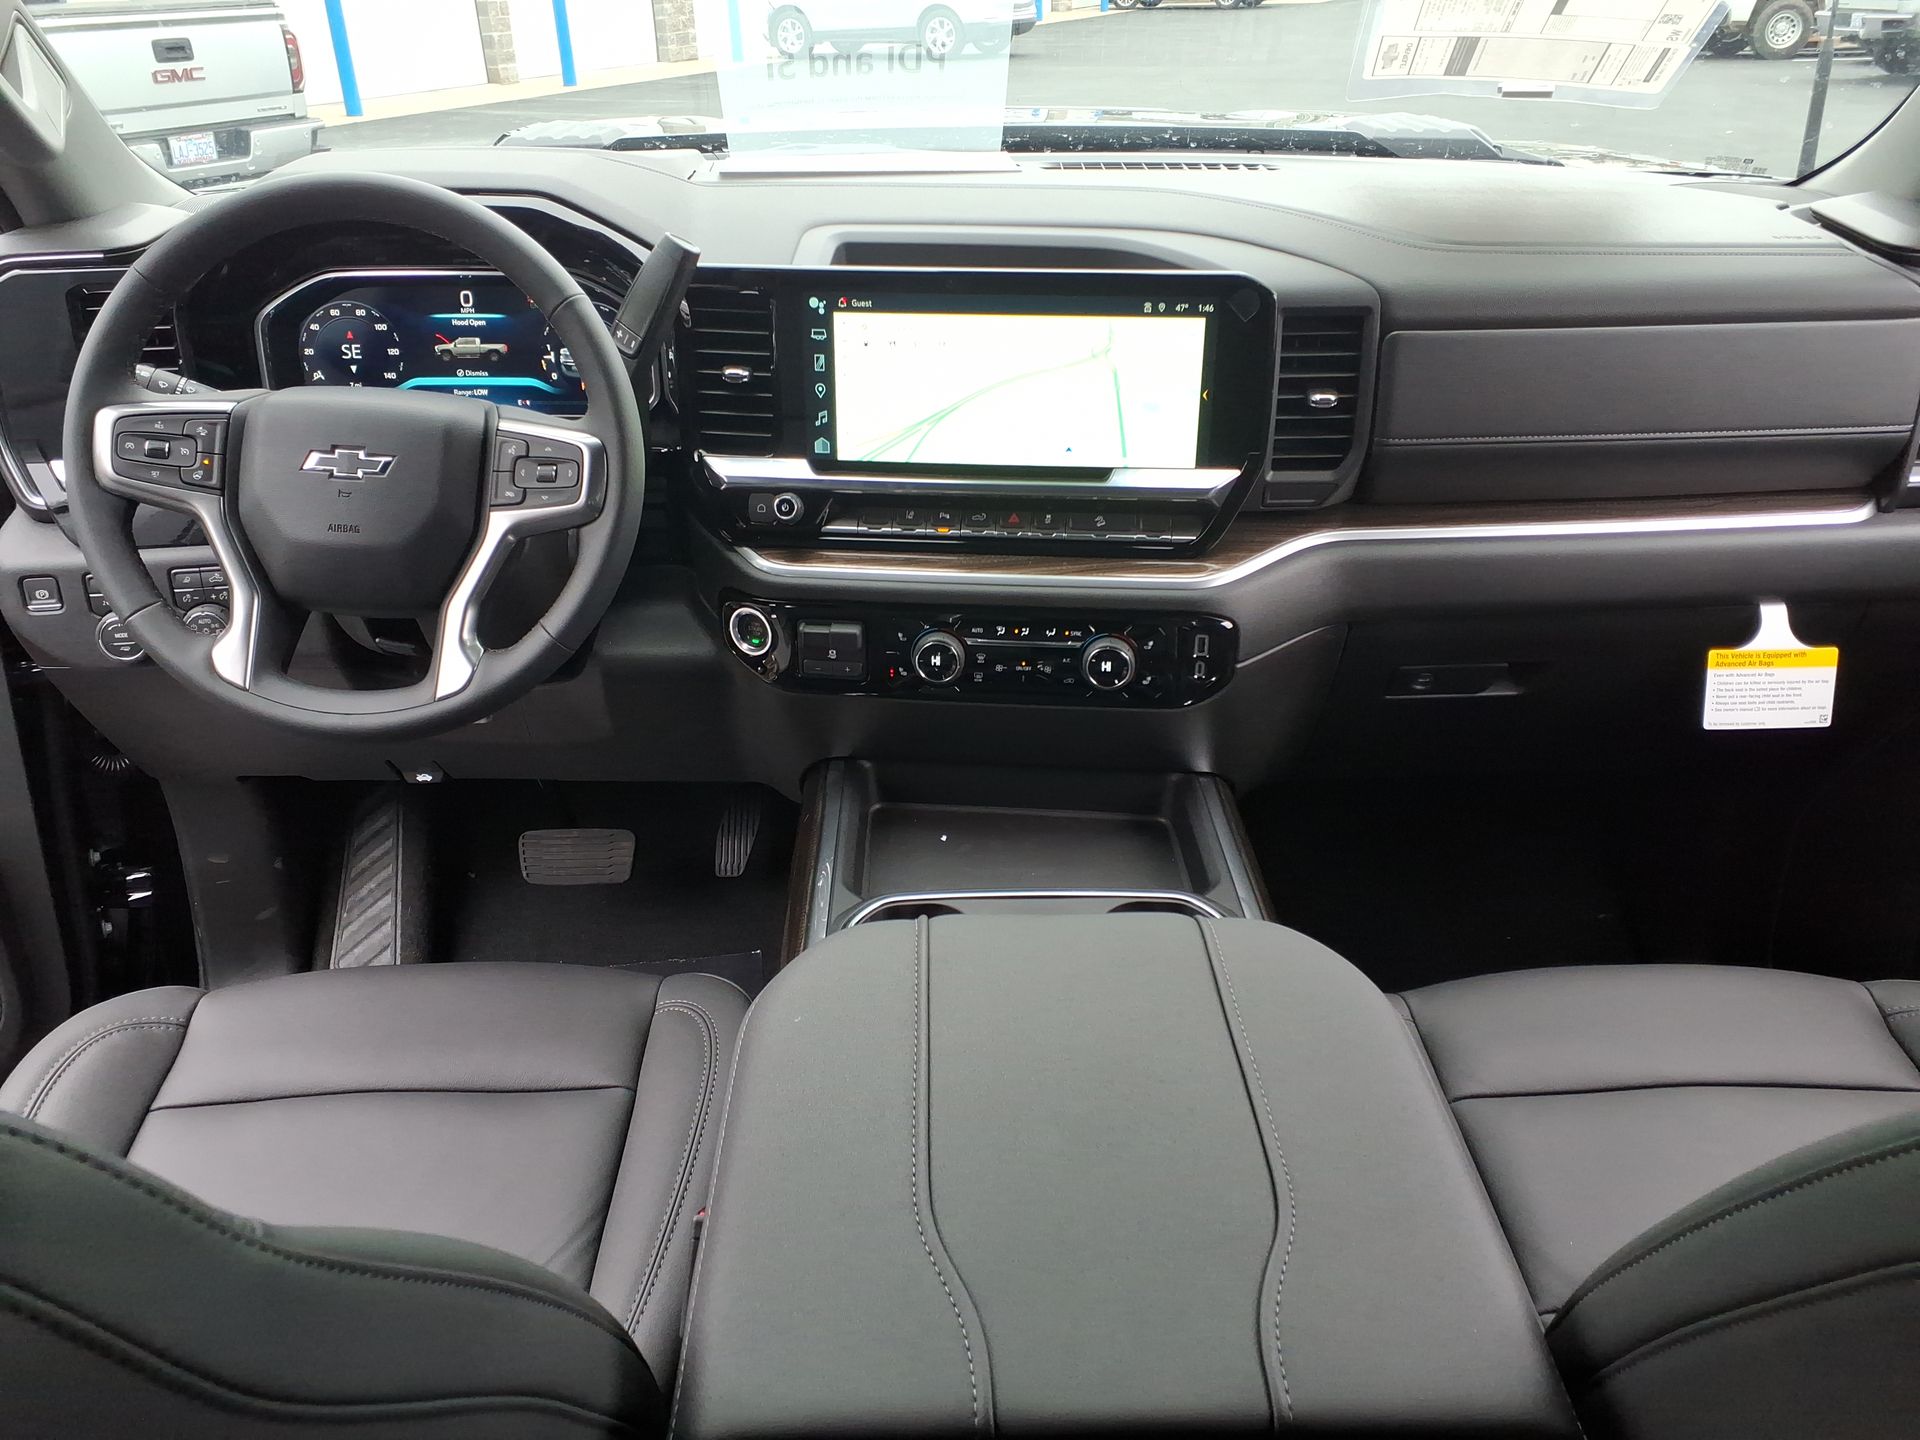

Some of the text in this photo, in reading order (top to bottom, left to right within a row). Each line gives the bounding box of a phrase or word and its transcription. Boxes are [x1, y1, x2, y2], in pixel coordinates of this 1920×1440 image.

[151, 67, 206, 84] GMC
[460, 290, 473, 307] 0
[852, 299, 872, 308] Guest
[1198, 304, 1214, 313] 1:46
[469, 319, 486, 327] Open
[341, 344, 362, 359] SE
[328, 524, 360, 534] AIRBAG
